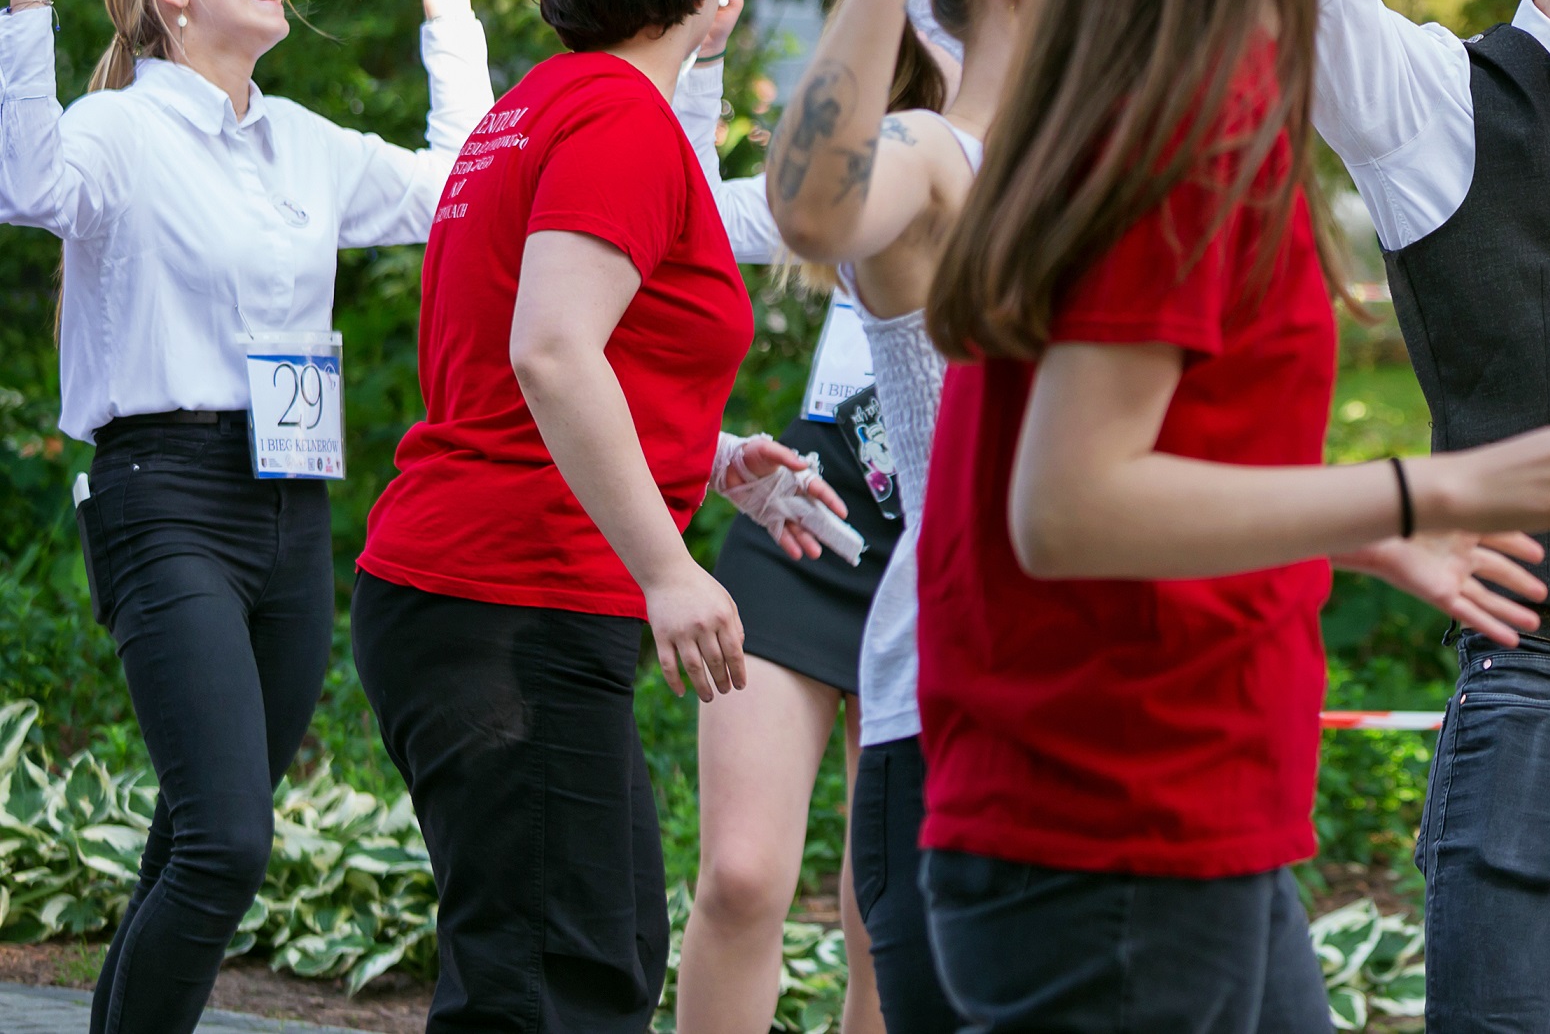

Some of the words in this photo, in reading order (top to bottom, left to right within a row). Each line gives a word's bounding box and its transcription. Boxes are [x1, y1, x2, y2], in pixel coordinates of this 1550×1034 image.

[473, 107, 528, 134] ENTRUM
[273, 363, 322, 429] 29
[819, 382, 824, 395] I
[268, 438, 292, 453] BIEG
[295, 438, 338, 453] KELNERÓW
